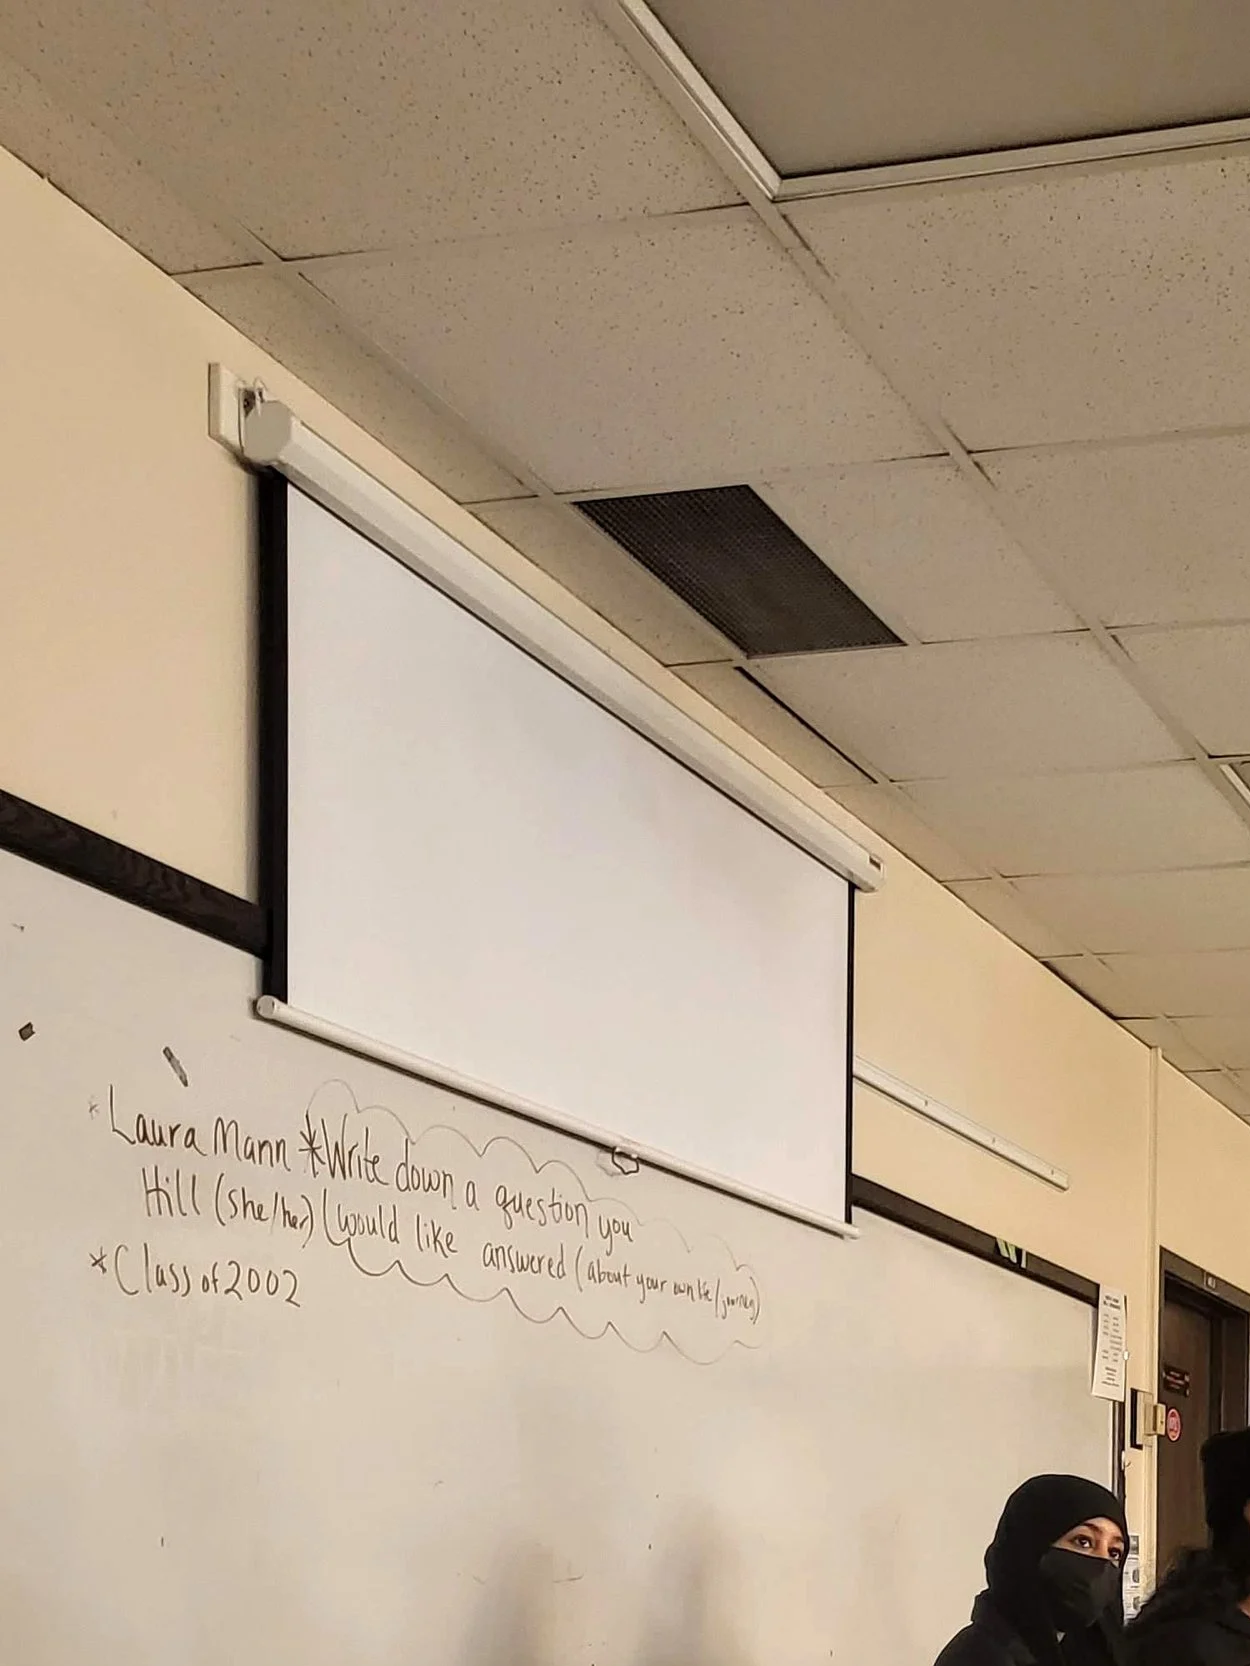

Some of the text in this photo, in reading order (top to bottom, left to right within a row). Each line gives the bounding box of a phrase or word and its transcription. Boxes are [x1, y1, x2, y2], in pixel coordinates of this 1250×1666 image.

[109, 1084, 291, 1171] Laura Mann
[142, 1165, 200, 1217] Hill
[321, 1113, 634, 1255] Write down a question you
[114, 1243, 301, 1307] Class of 2002
[416, 1214, 458, 1258] like
[482, 1243, 566, 1278] answered
[636, 1274, 667, 1303] your
